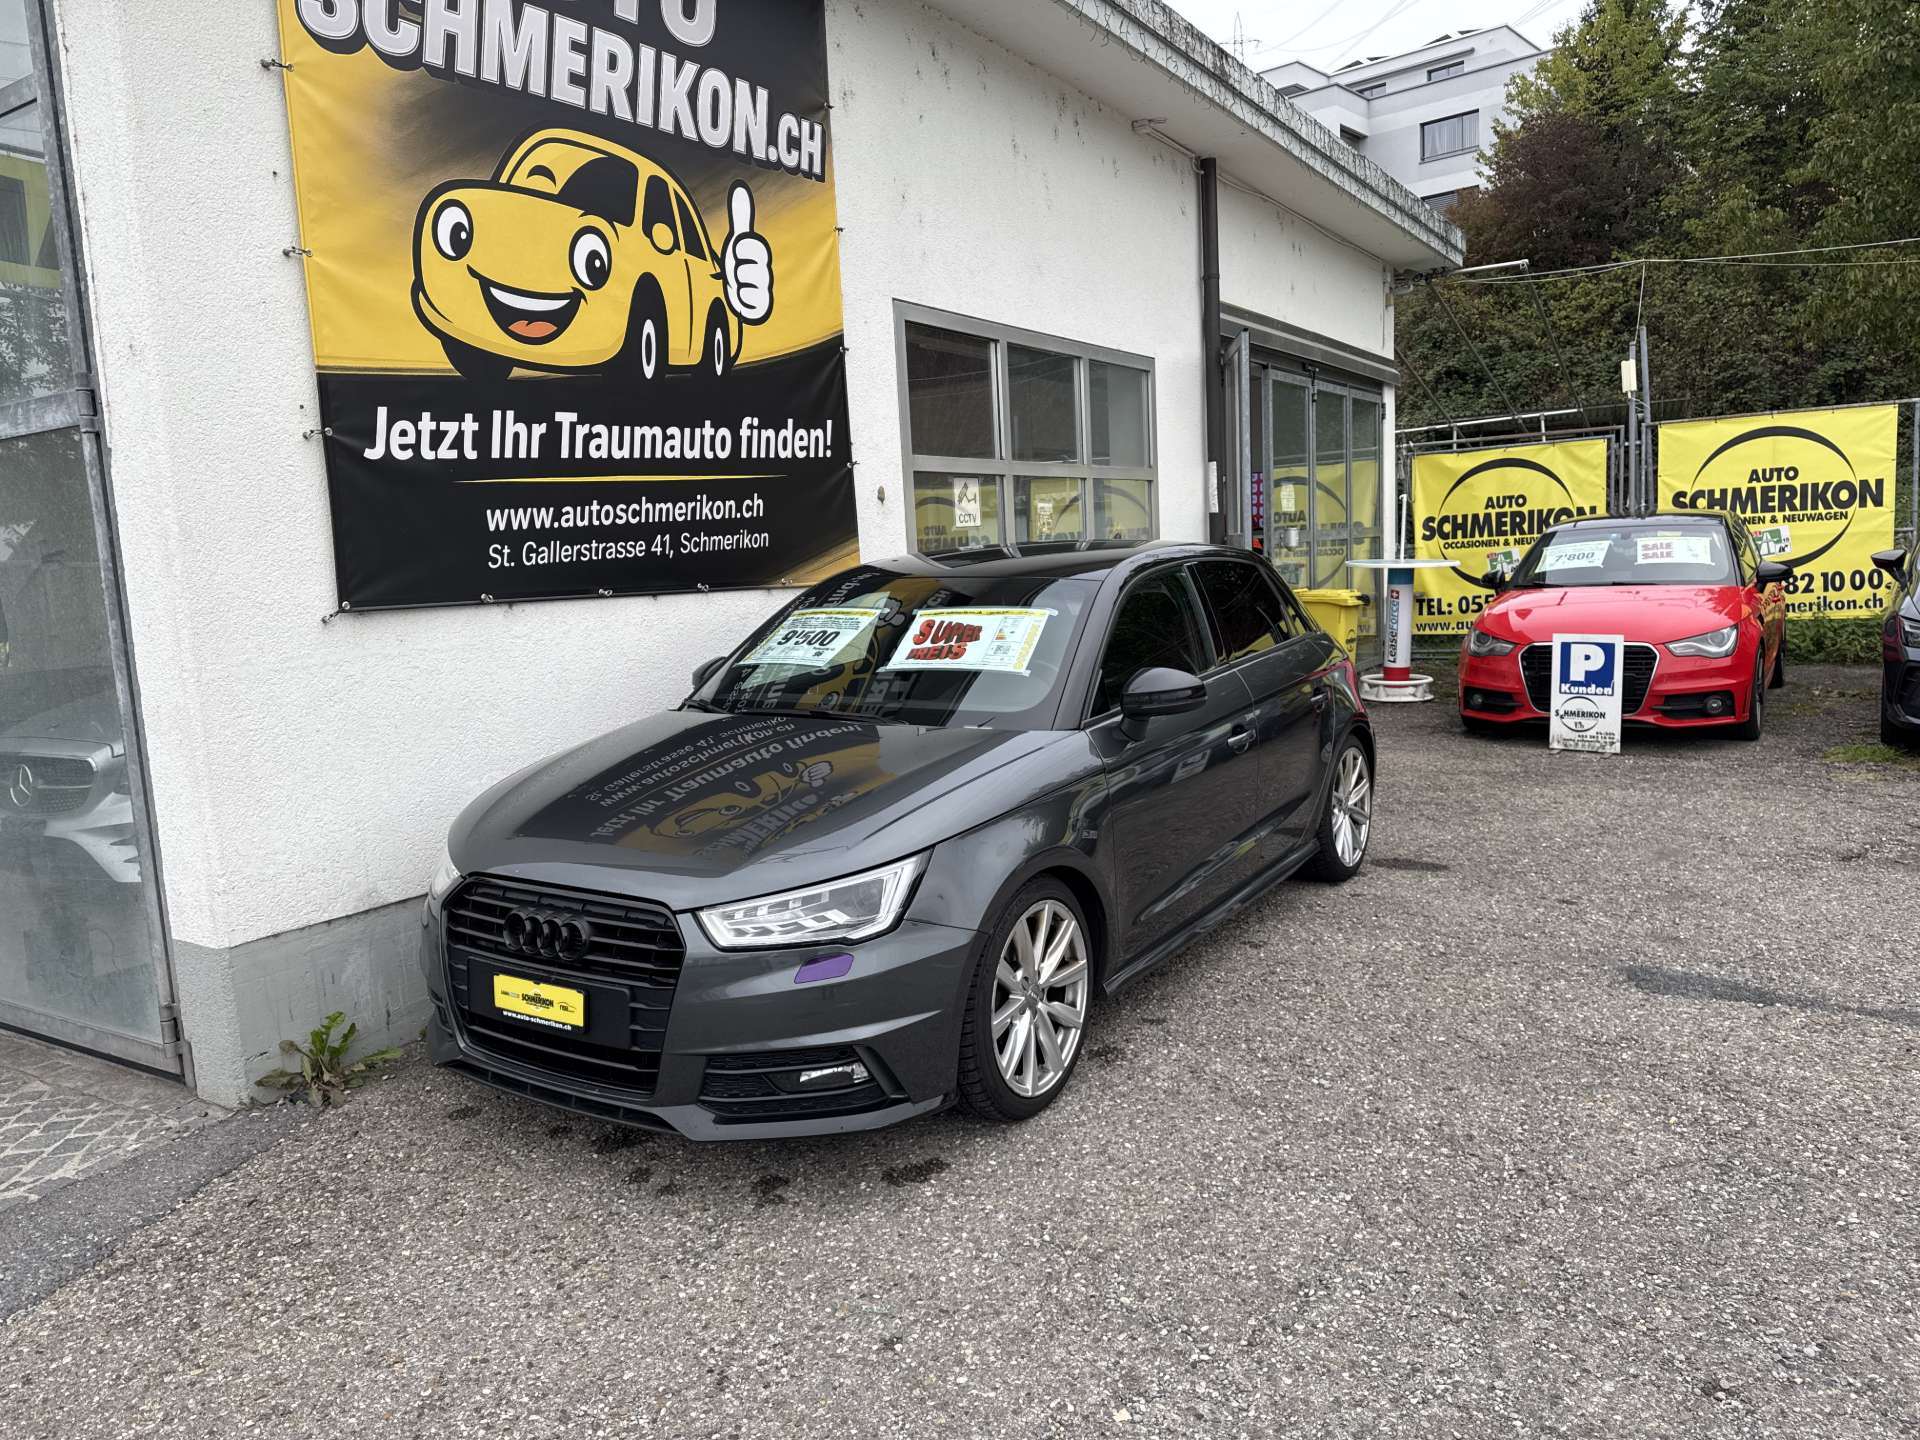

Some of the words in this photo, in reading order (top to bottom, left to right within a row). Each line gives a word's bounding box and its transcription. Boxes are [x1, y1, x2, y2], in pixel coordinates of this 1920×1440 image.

[364, 406, 479, 461] Jetzt
[491, 409, 547, 460] Ihr
[554, 411, 732, 460] Traumauto
[740, 417, 833, 459] finden!
[1748, 466, 1799, 484] AUTO
[1484, 494, 1527, 510] AUTO
[1671, 478, 1884, 514] SCHMERIKON
[486, 494, 764, 532] www.autoschmerikon.ch
[958, 511, 977, 525] CCTV
[1741, 514, 1766, 526] NEN
[1770, 514, 1779, 524] &
[1782, 510, 1849, 524] NEUWAGEN
[488, 544, 514, 569] St.
[522, 536, 646, 566] Gallerstrasse
[651, 535, 674, 560] 41,
[680, 531, 769, 554] Schmerikon
[1443, 539, 1500, 550] OCCASIONEN
[1503, 538, 1511, 548] &
[1641, 541, 1674, 551] SALE
[1554, 551, 1596, 563] 7'800
[1641, 550, 1674, 560] SALE
[1783, 572, 1815, 595] 82
[1820, 570, 1847, 593] 10
[1850, 567, 1884, 592] 00
[1416, 596, 1453, 616] TEL:
[777, 629, 841, 647] 9'500
[912, 619, 983, 645] SUPER
[1388, 600, 1400, 663] LeaseForce
[1569, 643, 1606, 682] P
[1561, 682, 1613, 695] Kunden
[1554, 709, 1606, 719] SCHMERIKON
